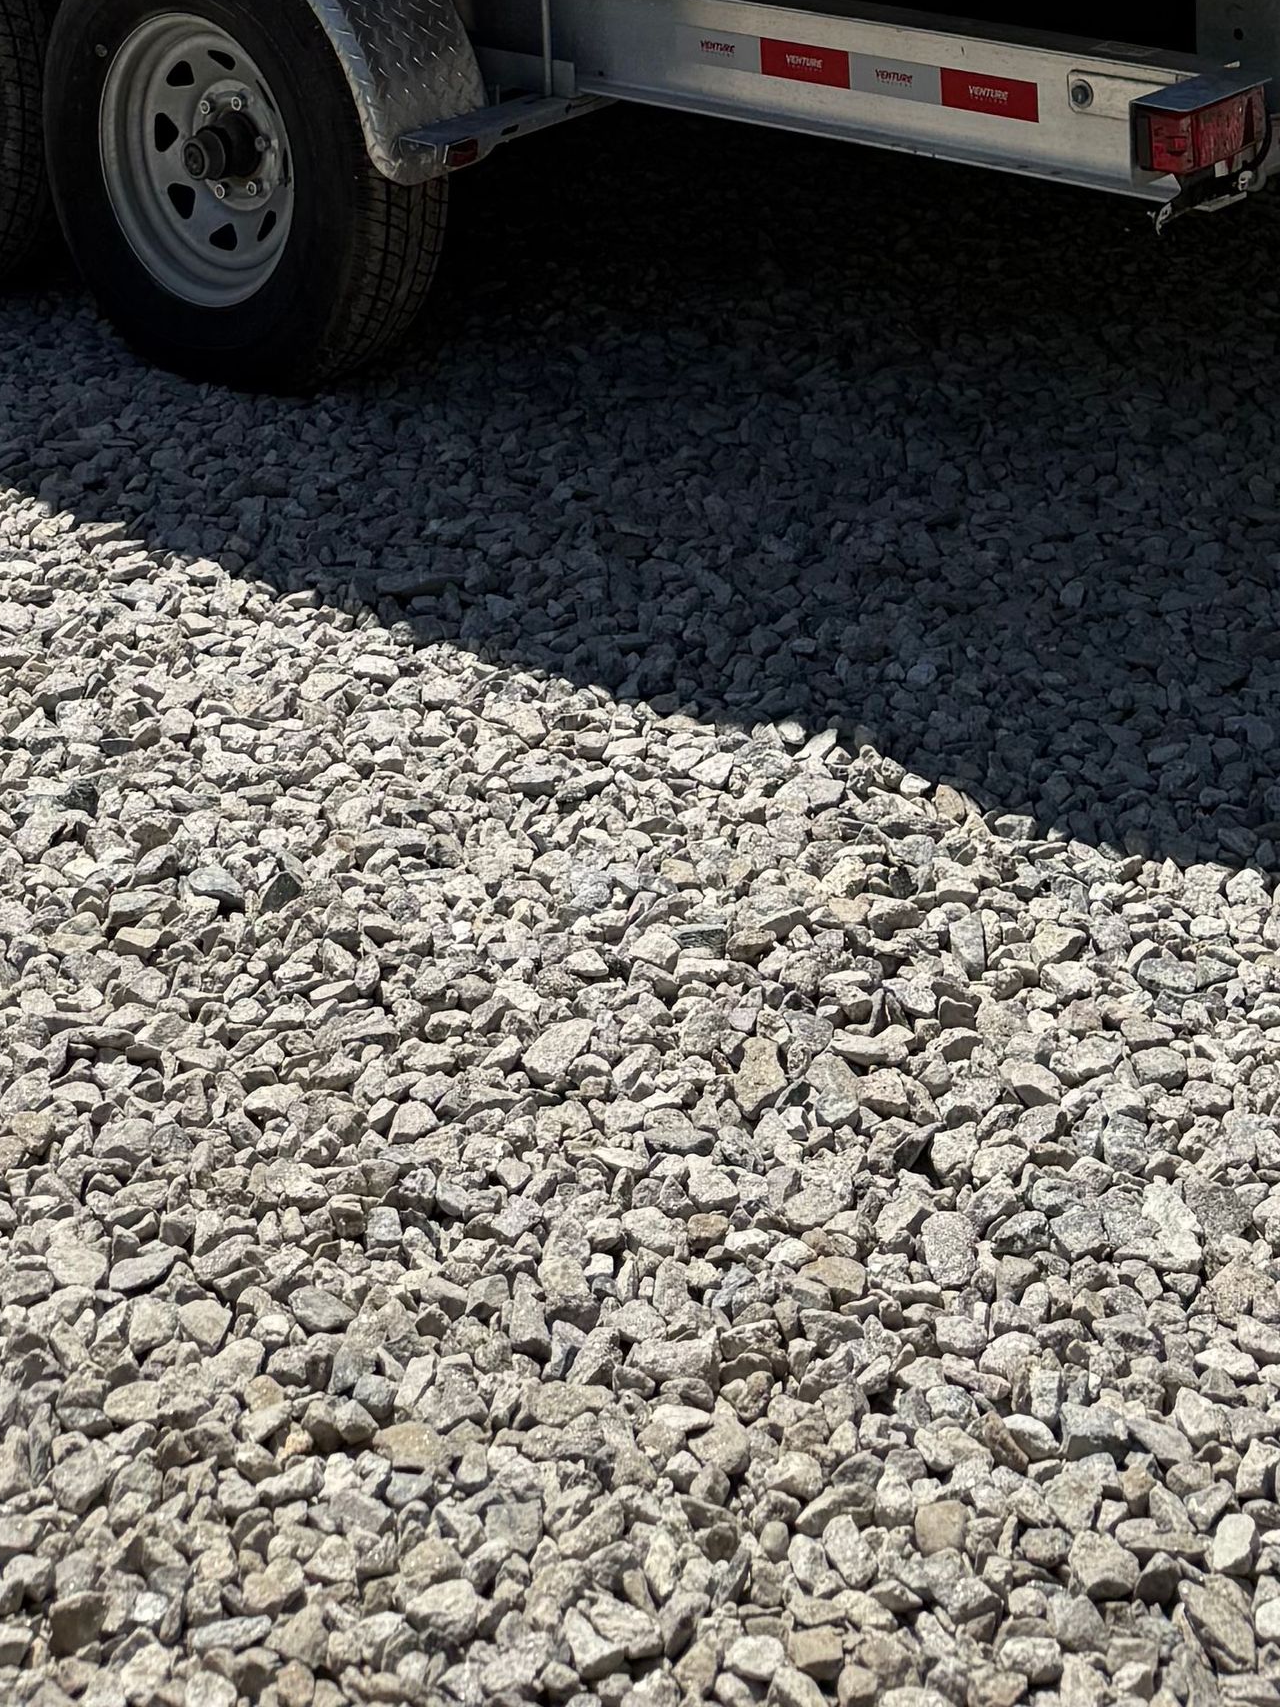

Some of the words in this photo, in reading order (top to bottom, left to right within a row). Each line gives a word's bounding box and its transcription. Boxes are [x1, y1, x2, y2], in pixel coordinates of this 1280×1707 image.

[700, 39, 735, 54] VENTURE
[785, 53, 823, 69] VENTURE
[875, 68, 913, 84] VENTURE
[968, 84, 1009, 101] VENTURE
